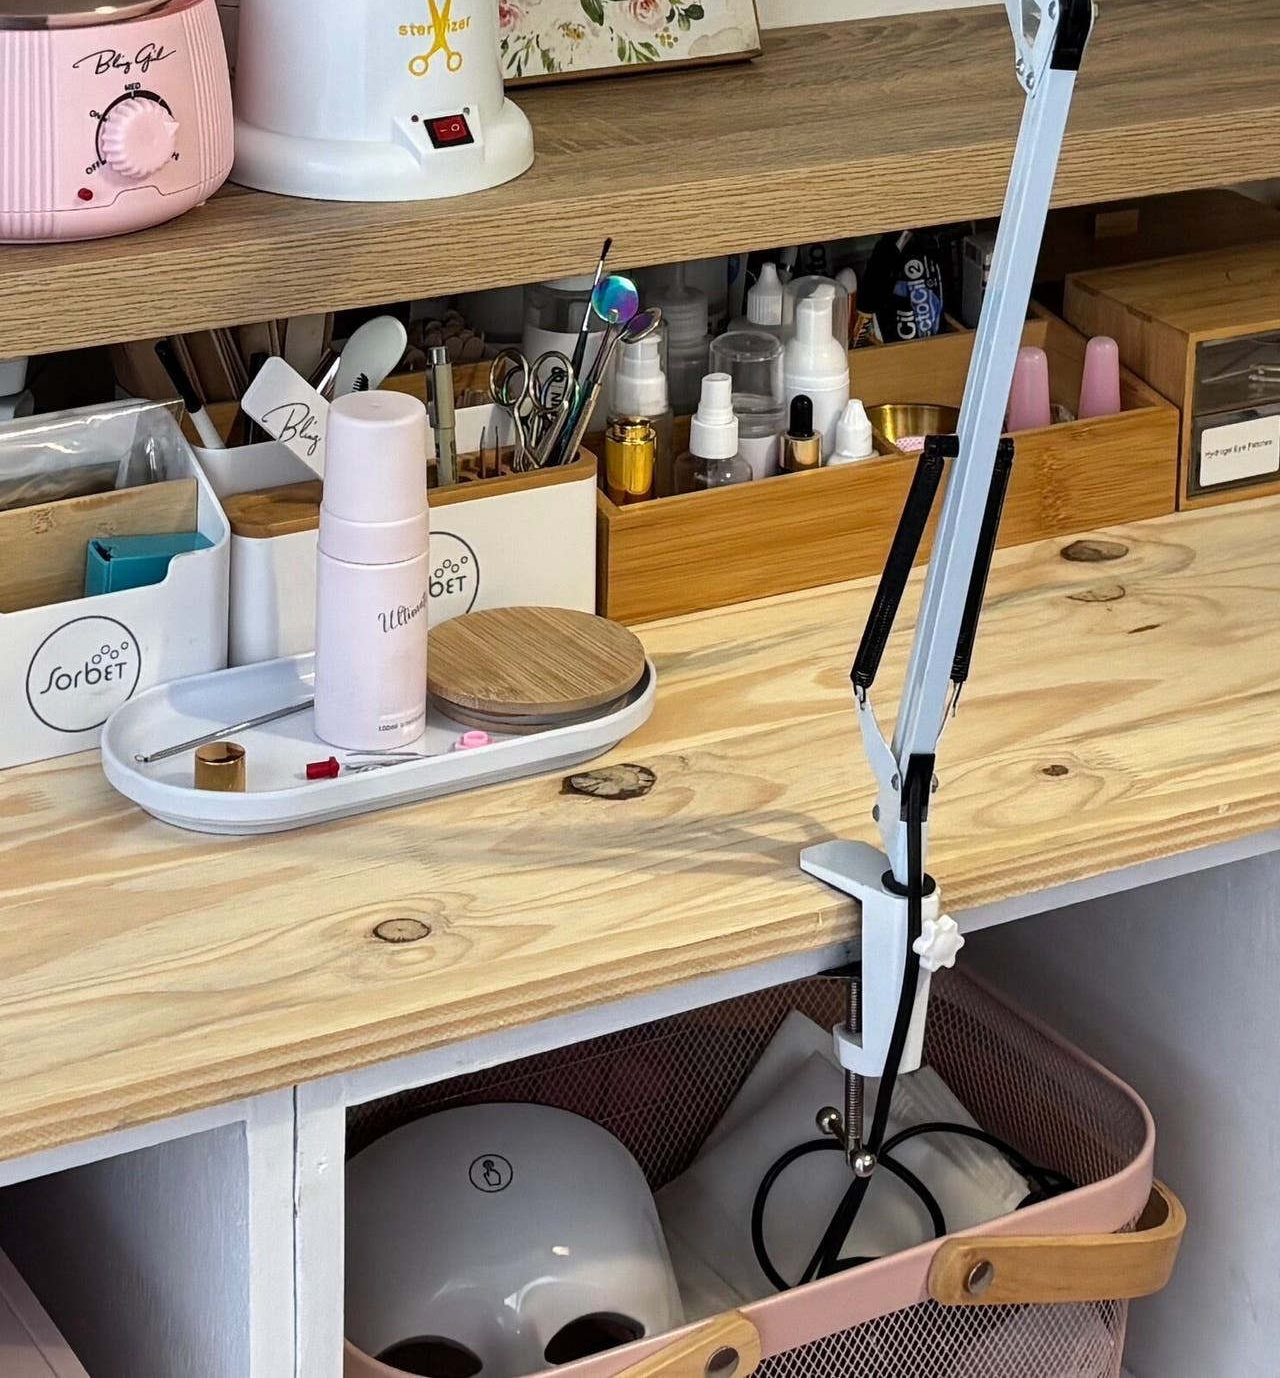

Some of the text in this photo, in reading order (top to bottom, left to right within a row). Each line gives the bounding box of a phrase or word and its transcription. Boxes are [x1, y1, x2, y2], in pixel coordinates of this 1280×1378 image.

[399, 16, 471, 36] sterizer
[72, 49, 133, 74] Bling
[124, 82, 141, 91] MED
[261, 402, 322, 456] Bling
[378, 591, 427, 633] Ultimat
